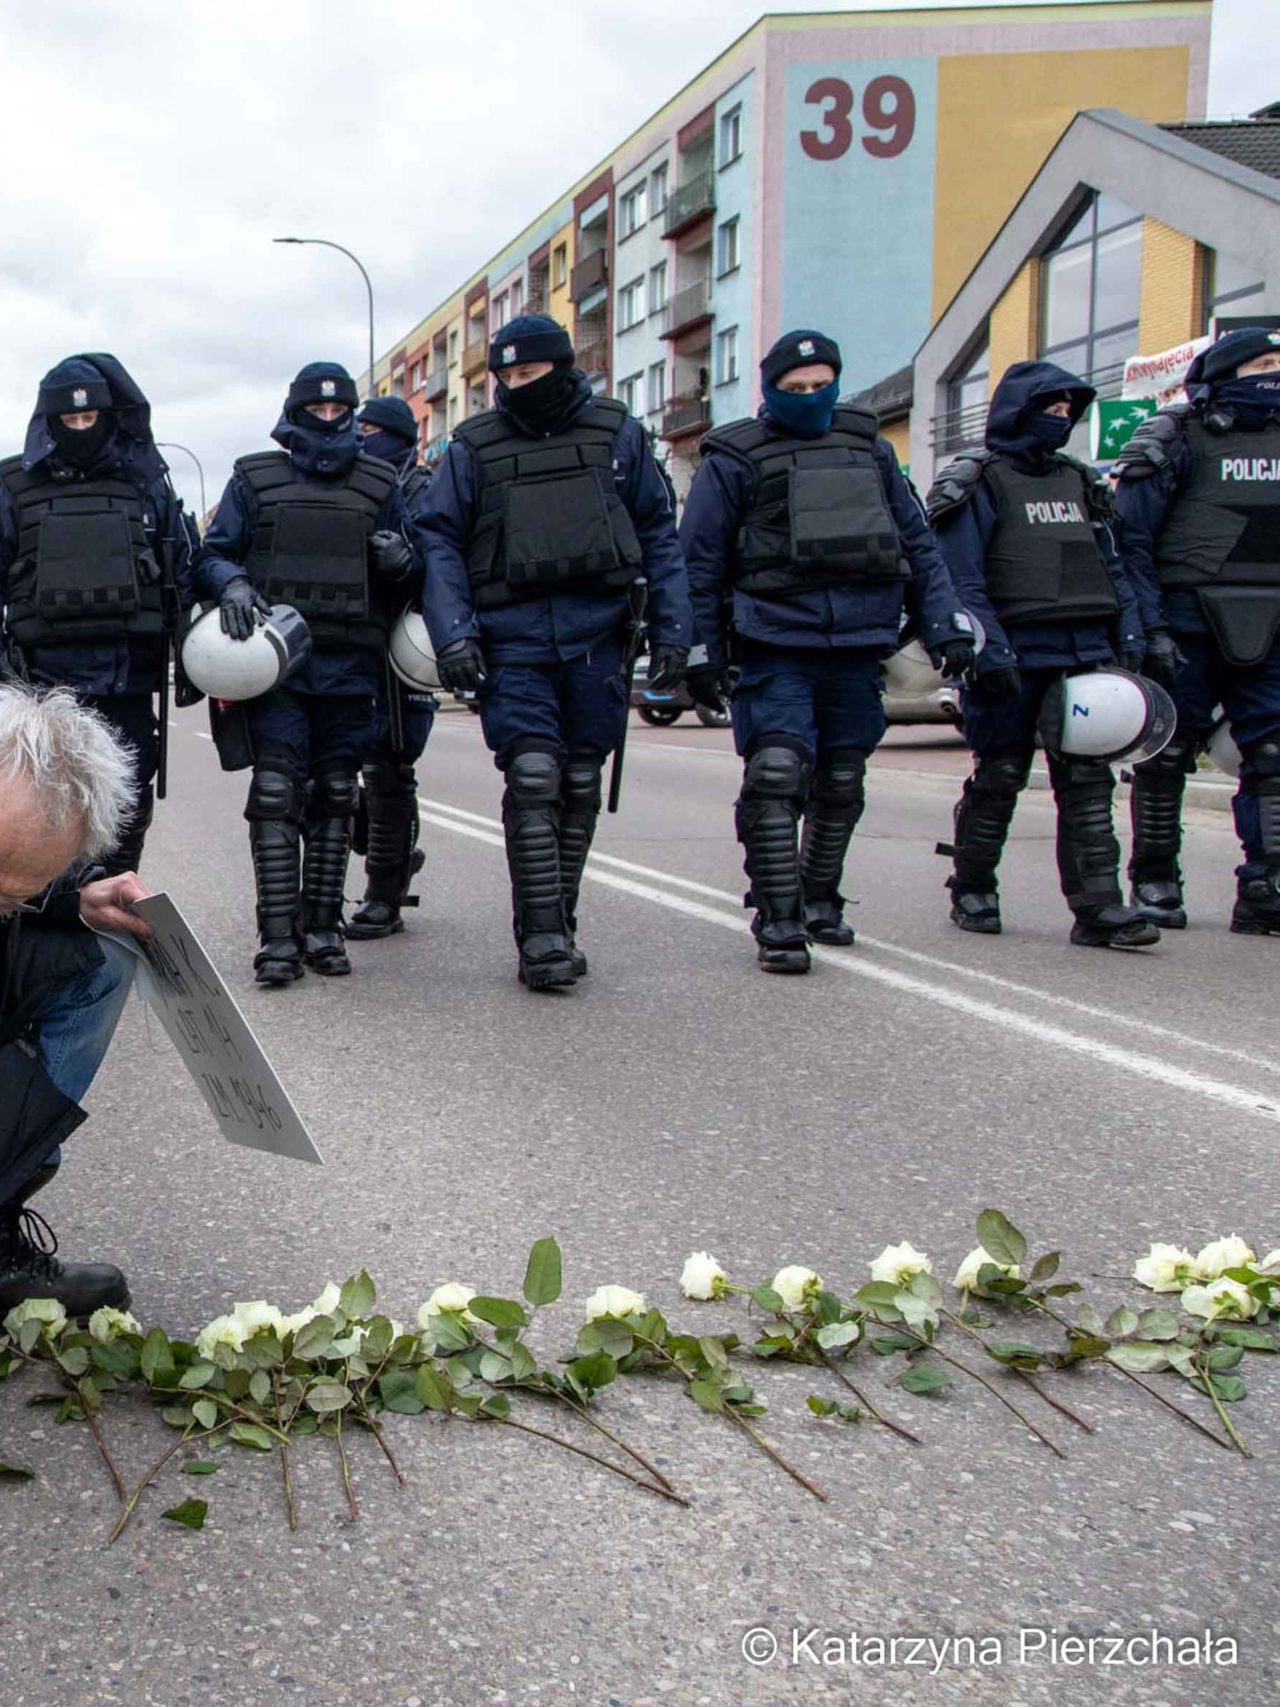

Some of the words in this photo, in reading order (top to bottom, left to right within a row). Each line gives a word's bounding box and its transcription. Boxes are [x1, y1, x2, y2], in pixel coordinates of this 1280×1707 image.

[800, 75, 916, 160] 39
[1025, 502, 1084, 524] POLICJA
[229, 1075, 282, 1134] 1946
